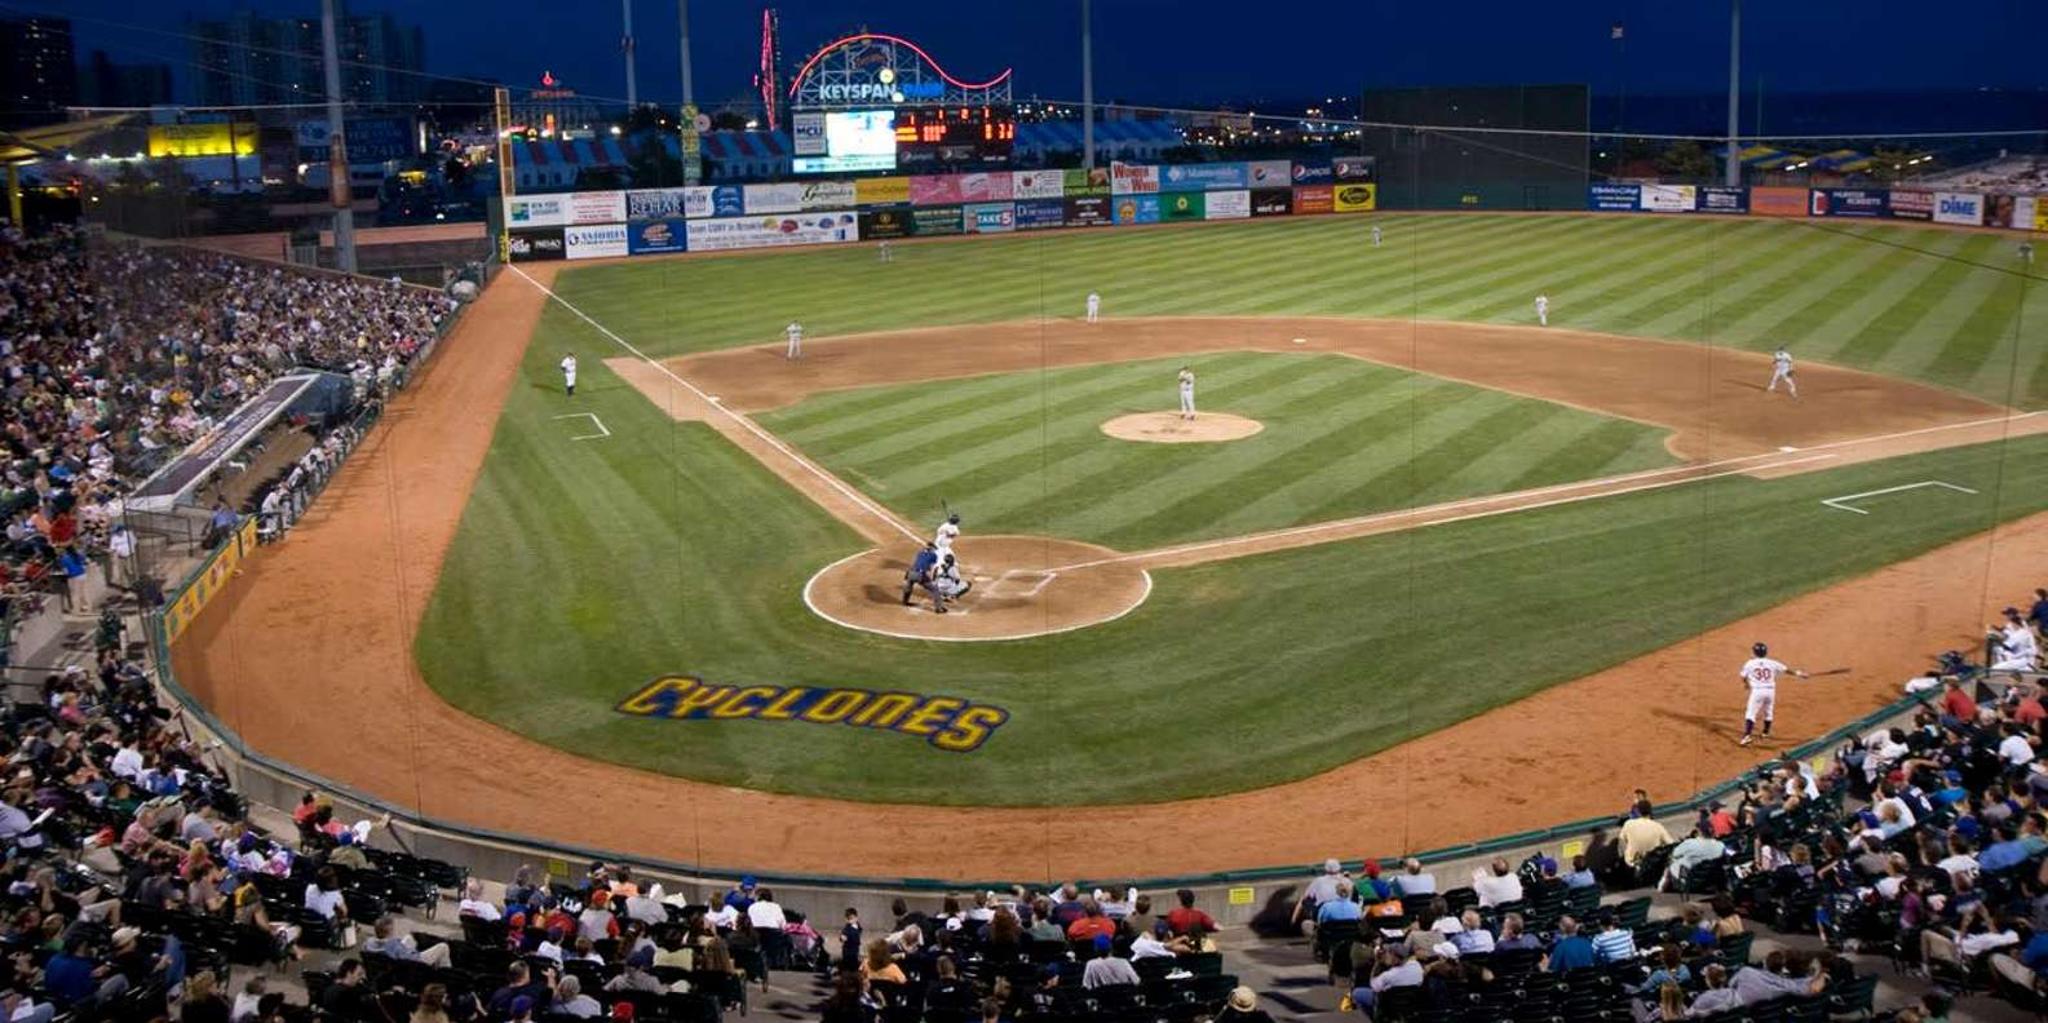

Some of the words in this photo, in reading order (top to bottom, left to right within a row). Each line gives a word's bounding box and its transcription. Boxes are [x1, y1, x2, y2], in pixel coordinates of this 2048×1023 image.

[820, 85, 895, 99] KEYSPAN
[977, 214, 1000, 225] TAKE
[1001, 212, 1012, 224] 5
[1753, 667, 1771, 681] 30
[615, 675, 1009, 752] CYCLONES
